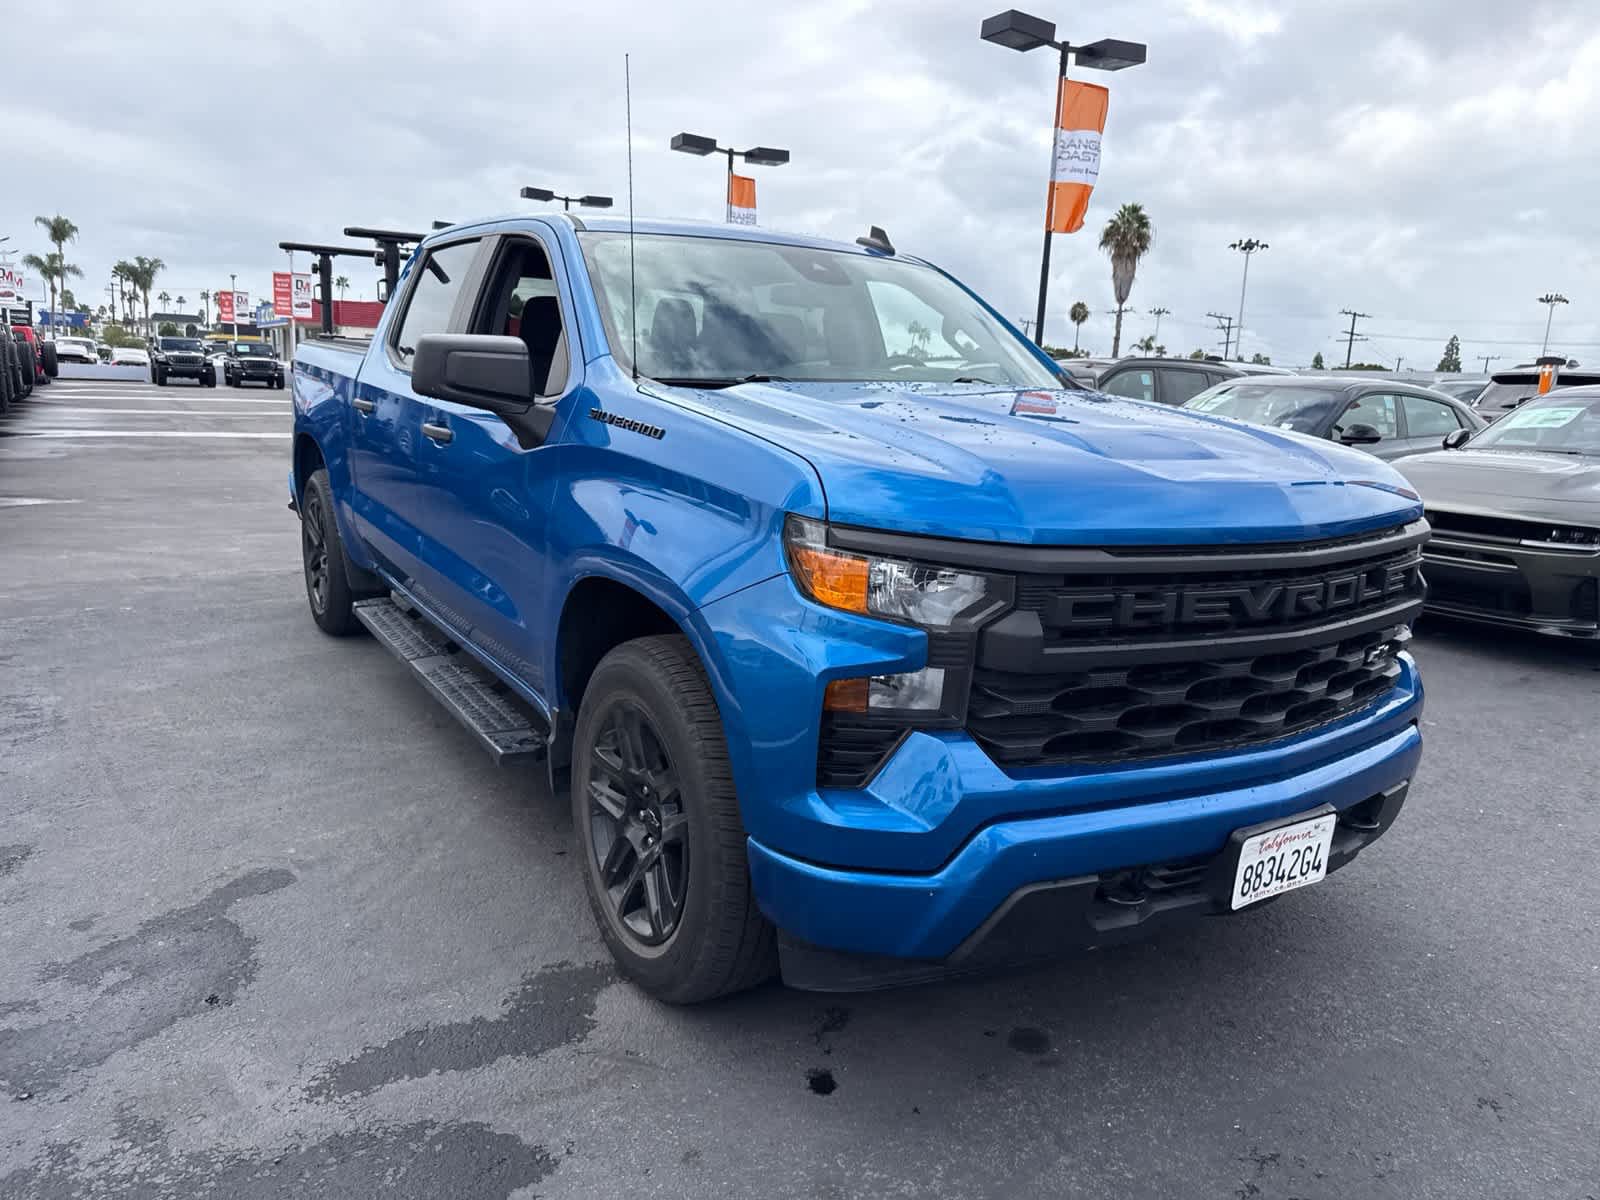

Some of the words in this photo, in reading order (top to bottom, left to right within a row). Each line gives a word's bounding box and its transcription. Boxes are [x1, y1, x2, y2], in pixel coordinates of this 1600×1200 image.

[1058, 150, 1098, 163] OAST
[590, 408, 666, 440] SILVERADO
[1046, 560, 1423, 629] CHEVROLET
[1258, 830, 1316, 855] California
[1240, 842, 1322, 897] 88342G4
